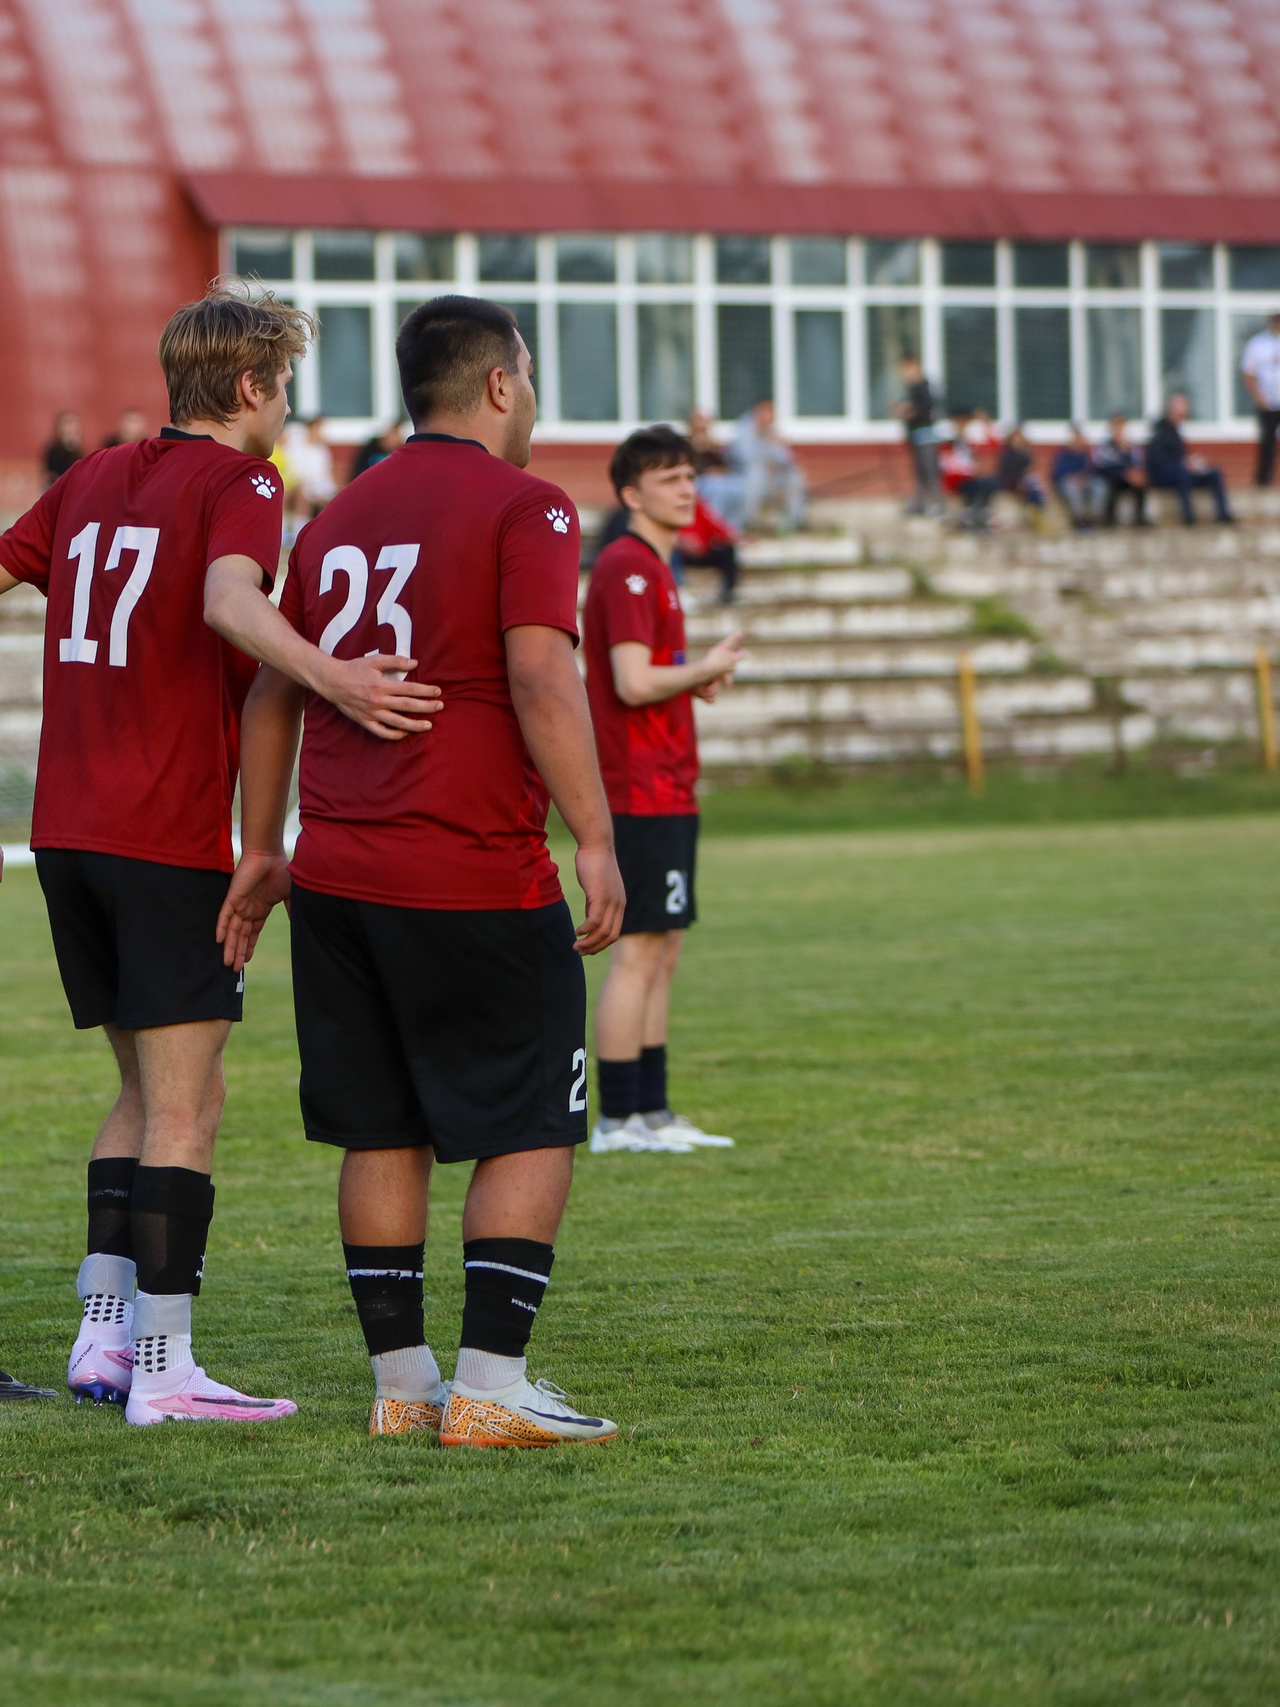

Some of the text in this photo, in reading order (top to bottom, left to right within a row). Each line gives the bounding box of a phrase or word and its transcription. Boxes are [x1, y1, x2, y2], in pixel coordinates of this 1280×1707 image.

[59, 521, 160, 667] 17
[319, 543, 419, 682] 23
[569, 1047, 587, 1112] 2
